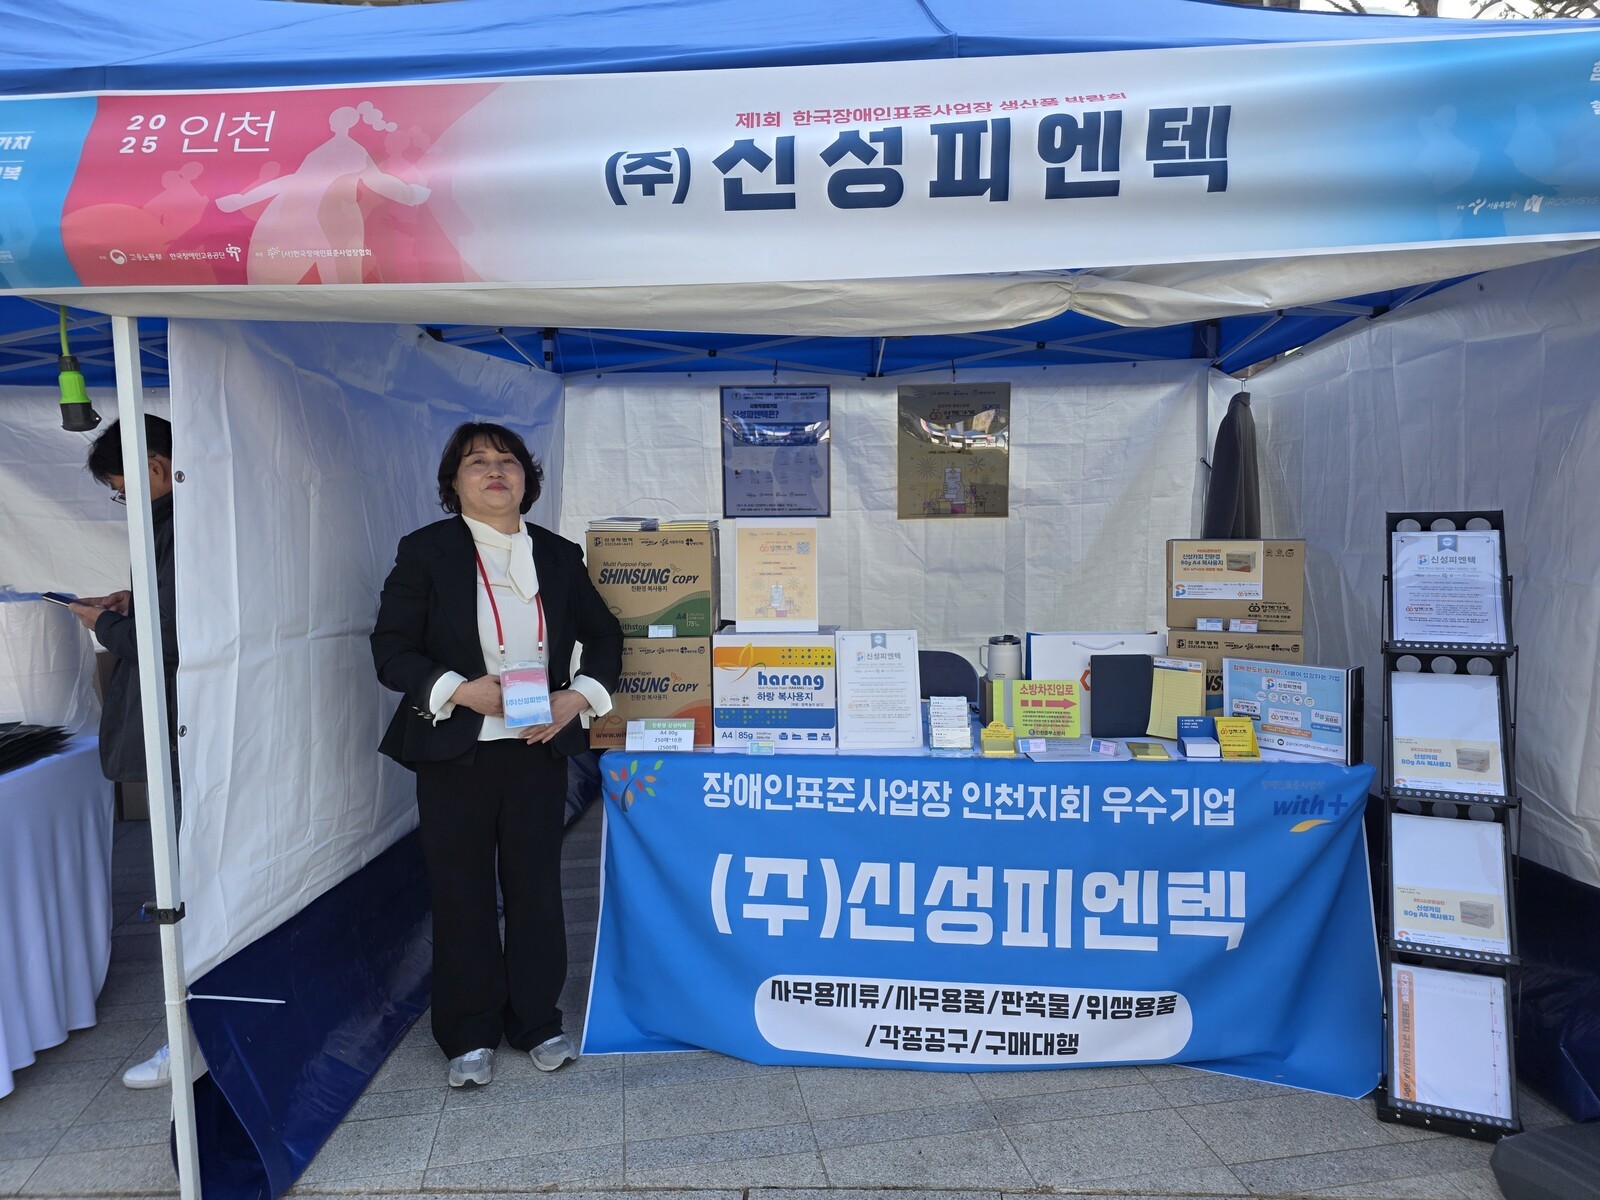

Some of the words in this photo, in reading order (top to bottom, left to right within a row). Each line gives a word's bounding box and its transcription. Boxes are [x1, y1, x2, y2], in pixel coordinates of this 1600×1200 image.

[734, 111, 781, 128] 제1회
[792, 101, 993, 126] 한국장애인표준사업장
[126, 114, 167, 131] 20
[178, 110, 277, 154] 인천
[119, 137, 158, 154] 25
[604, 147, 691, 206] (주)
[711, 105, 1232, 212] 신성피엔텍
[129, 253, 163, 262] 고용노동부
[169, 251, 226, 261] 한국장애인고용공단
[281, 248, 372, 258] (사)한국장애인표준사업장협회
[1430, 555, 1476, 564] 신성피엔텍
[598, 568, 671, 585] SHINSUNG
[672, 575, 699, 584] COPY
[676, 612, 686, 620] A4
[866, 652, 901, 660] 신성피엔텍
[1246, 665, 1263, 673] 만드는
[1285, 670, 1302, 678] 더불어
[1303, 672, 1327, 681] 성장하는
[758, 671, 824, 690] harang
[672, 683, 699, 692] COPY
[1020, 683, 1074, 696] 소방차진입로
[757, 691, 775, 701] 하랑
[778, 691, 813, 701] 복사용지
[738, 732, 754, 740] 85g
[1401, 758, 1415, 766] 80g
[702, 770, 952, 818] 장애인표준사업장
[962, 784, 1092, 823] 인천지회
[1101, 787, 1236, 827] 우수기업
[710, 853, 1246, 952] (주)신성피엔텍
[1403, 909, 1418, 918] 80g
[1430, 913, 1455, 921] 복사용지
